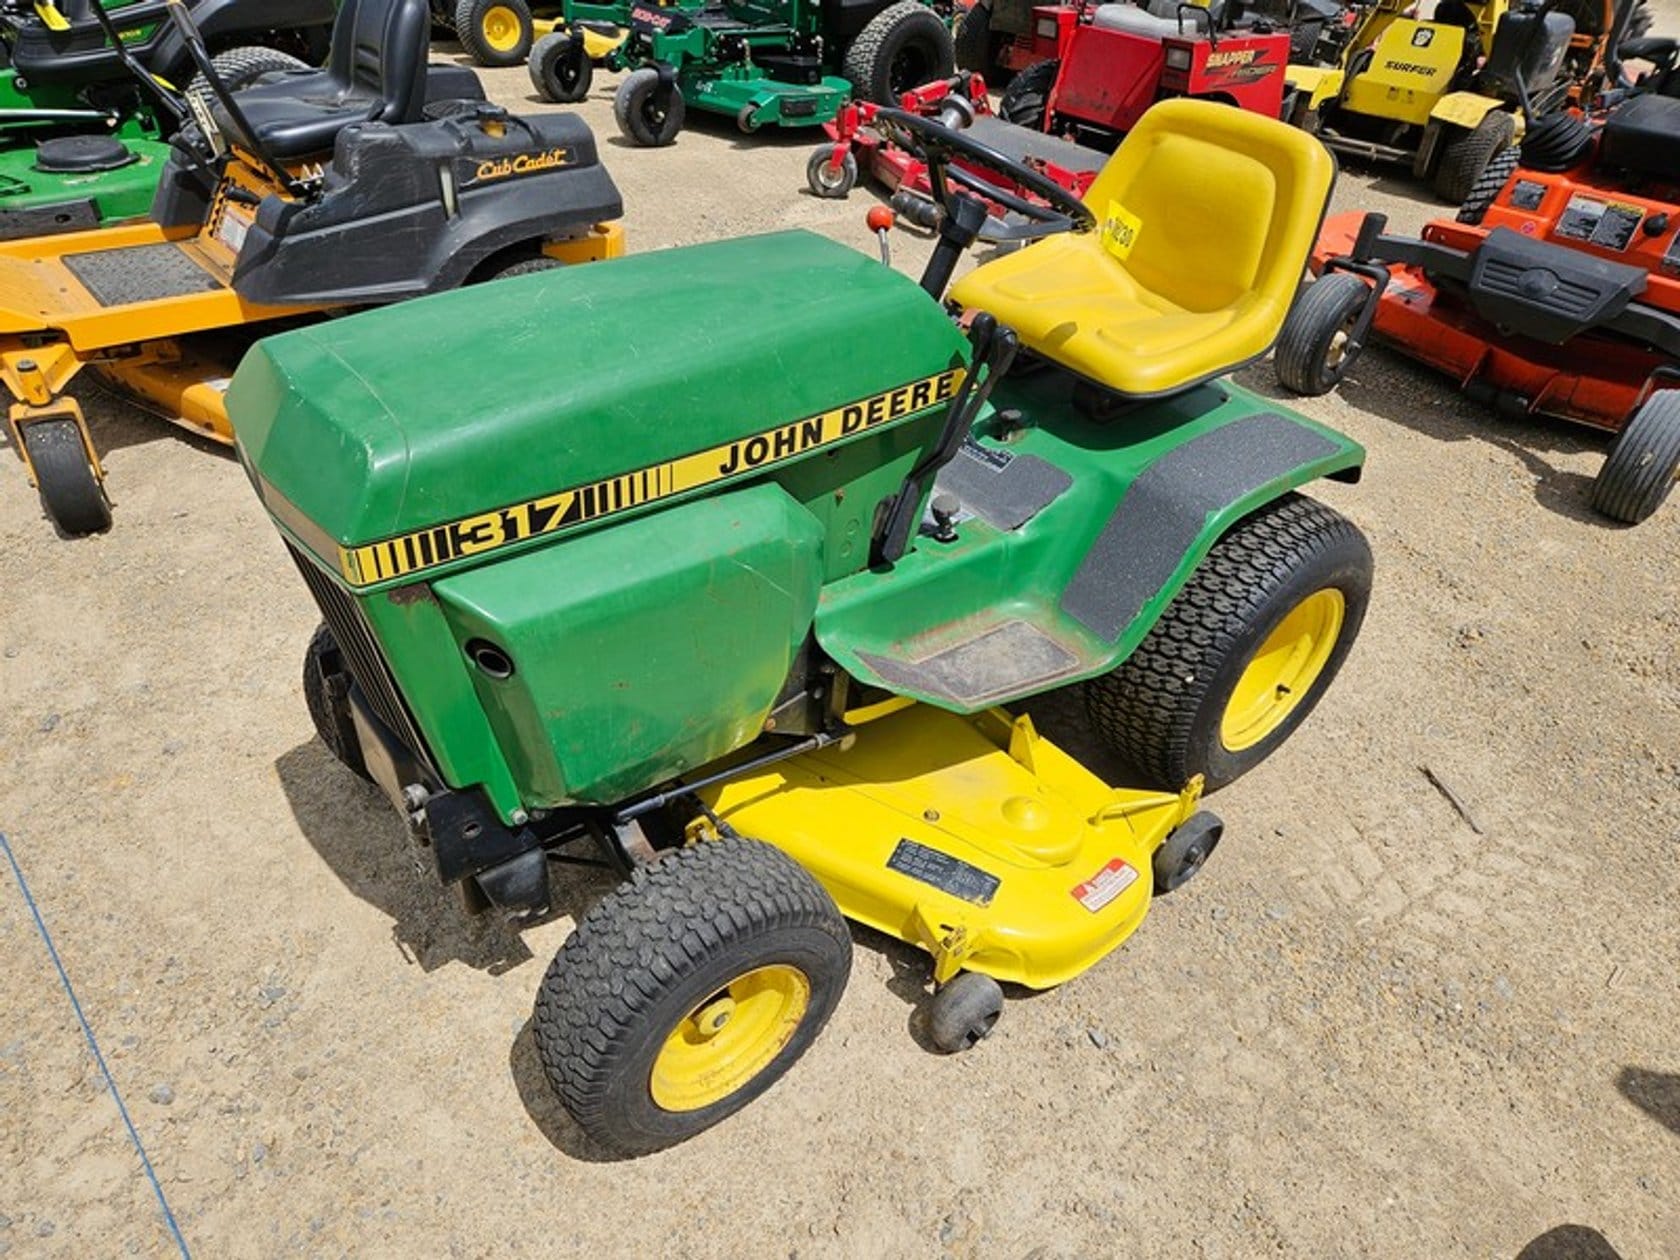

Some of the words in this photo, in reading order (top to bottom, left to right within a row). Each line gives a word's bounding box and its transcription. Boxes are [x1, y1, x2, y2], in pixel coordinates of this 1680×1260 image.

[1384, 60, 1438, 77] SURFER
[477, 158, 512, 179] Cub
[512, 147, 567, 173] Cadet
[458, 491, 575, 555] 317
[719, 417, 823, 475] JOHN
[841, 372, 954, 436] DEERE
